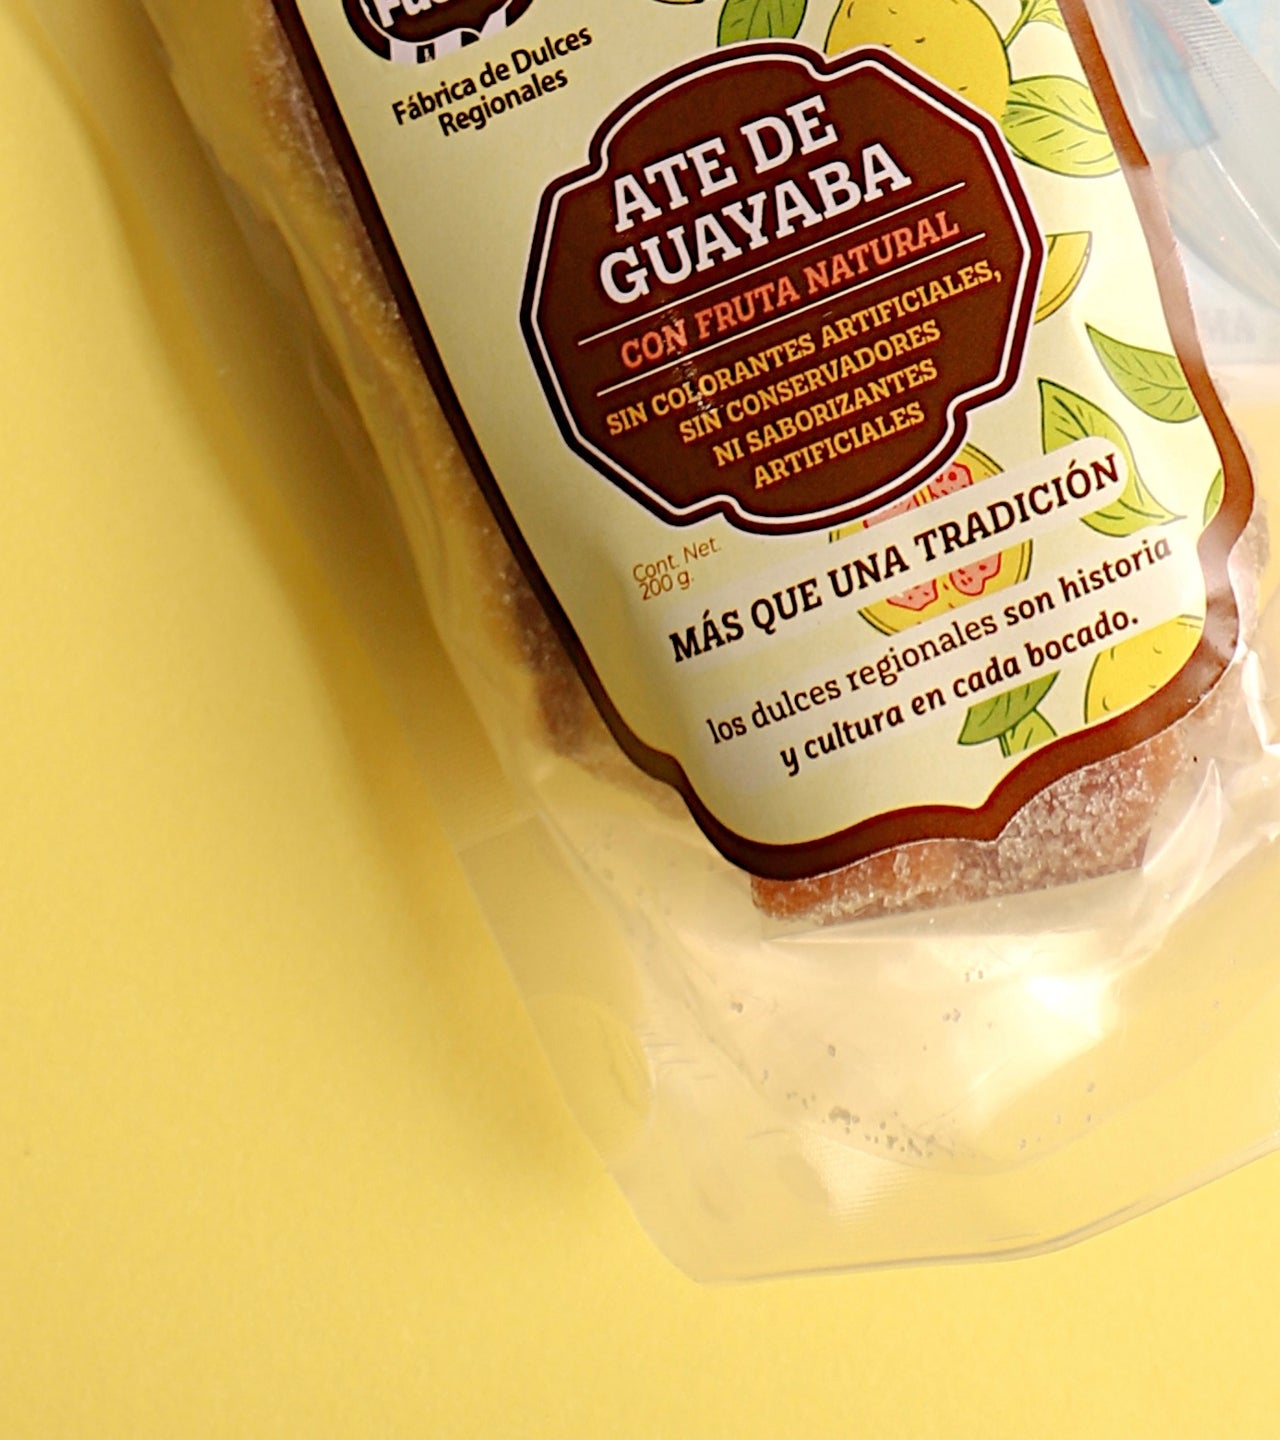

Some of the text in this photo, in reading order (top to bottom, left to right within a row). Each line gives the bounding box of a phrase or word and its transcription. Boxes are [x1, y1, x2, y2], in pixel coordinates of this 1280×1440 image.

[392, 27, 594, 127] Fábrica de Dulces
[439, 68, 569, 138] Regionales
[598, 142, 912, 305] GUAYABA
[612, 96, 839, 233] ATE DE
[620, 211, 961, 371] CON FRUTA NATURAL
[606, 335, 815, 437] SIN COLORANTES
[679, 320, 942, 444] SIN CONSERVADORES
[712, 360, 938, 467] NI SABORIZANTES
[752, 402, 925, 491] ARTIFICIALES
[668, 453, 1121, 664] MÁS QUE UNA TRADICIÓN
[706, 537, 1173, 745] los dulces regionales son historia
[802, 609, 1139, 752] cultura en cada bocado.
